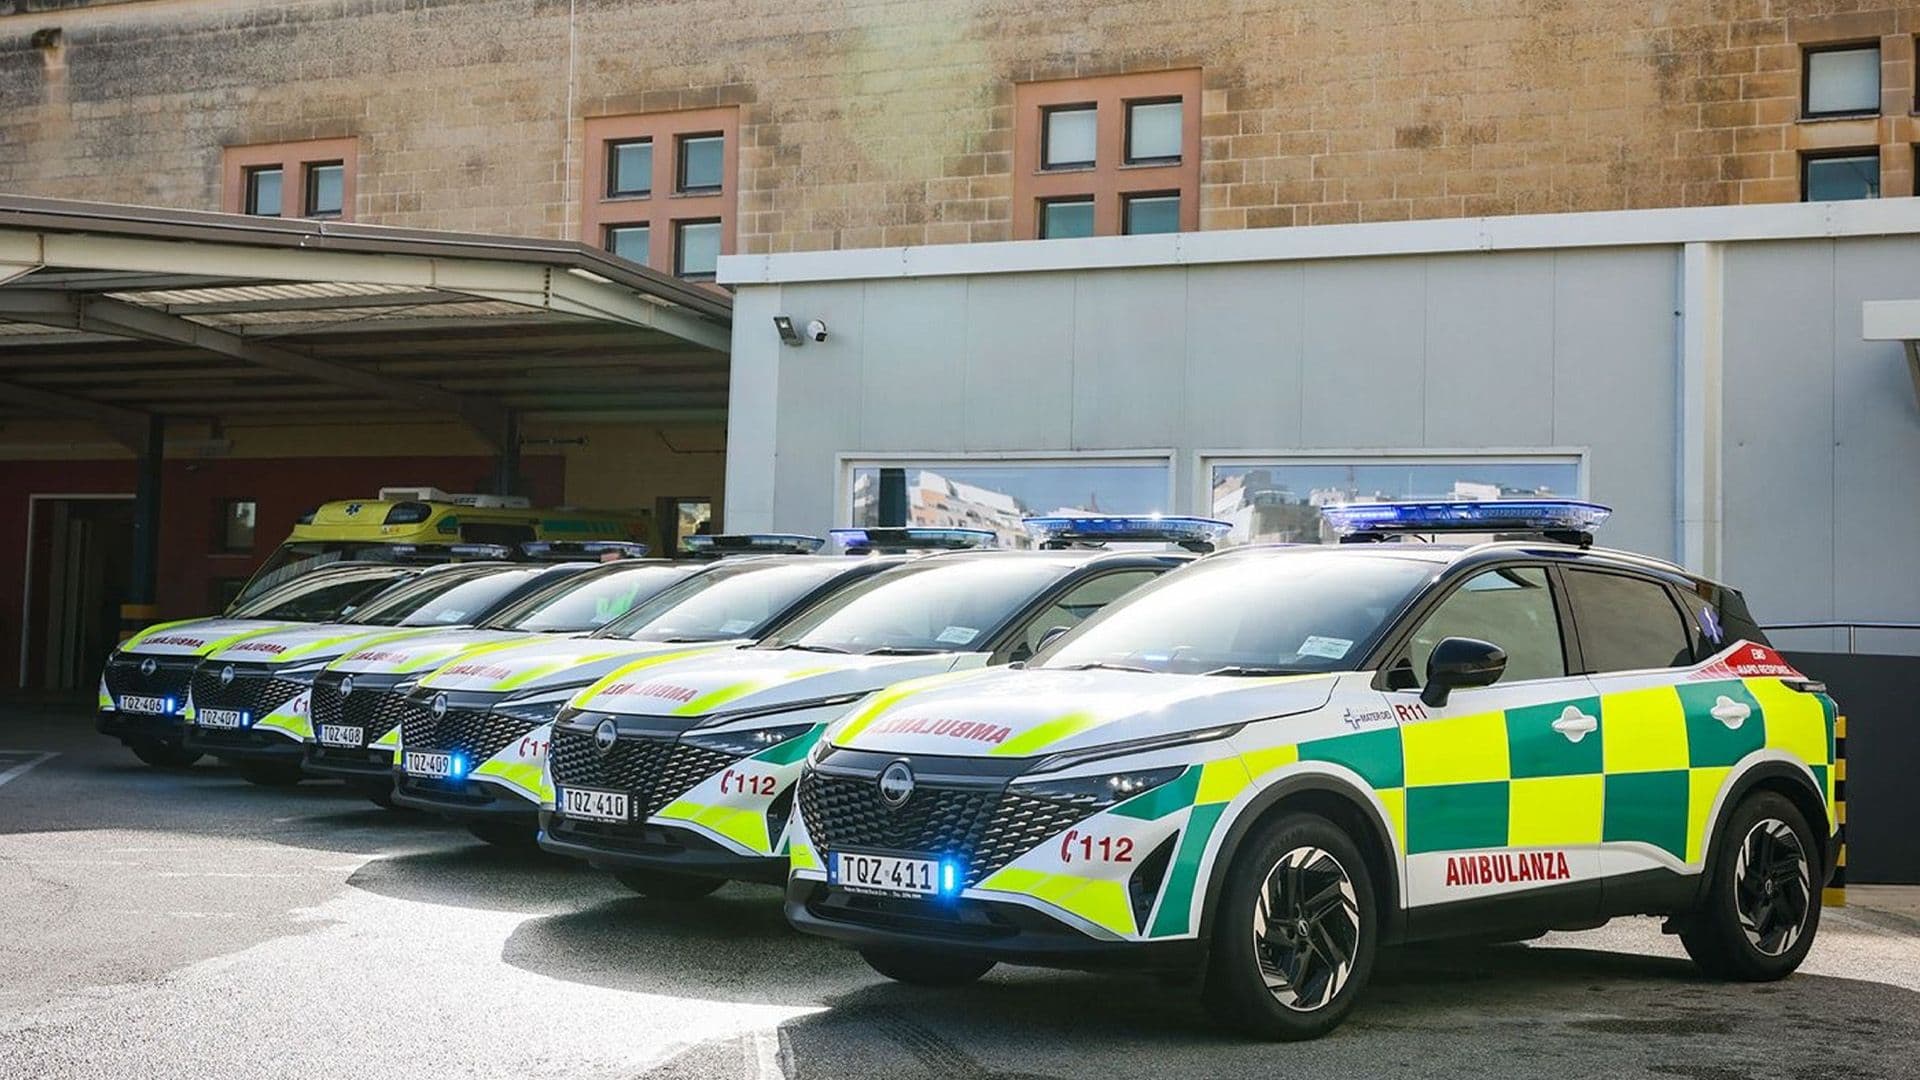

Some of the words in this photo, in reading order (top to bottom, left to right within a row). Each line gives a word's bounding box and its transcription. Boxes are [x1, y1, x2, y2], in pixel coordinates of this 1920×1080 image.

[123, 696, 141, 710] TQZ
[143, 697, 162, 712] 406
[1395, 704, 1427, 721] R11
[201, 710, 218, 724] TQZ
[220, 711, 237, 726] 407
[324, 726, 340, 741] TQZ
[342, 728, 361, 744] 408
[531, 740, 550, 756] 11
[407, 754, 427, 772] TQZ
[429, 755, 449, 773] 409
[735, 774, 776, 795] 112
[566, 790, 591, 814] TQZ
[597, 795, 624, 817] 410
[1080, 836, 1134, 862] 112
[844, 856, 882, 885] TQZ
[891, 861, 931, 890] 411
[1446, 852, 1570, 887] AMBULANZA
